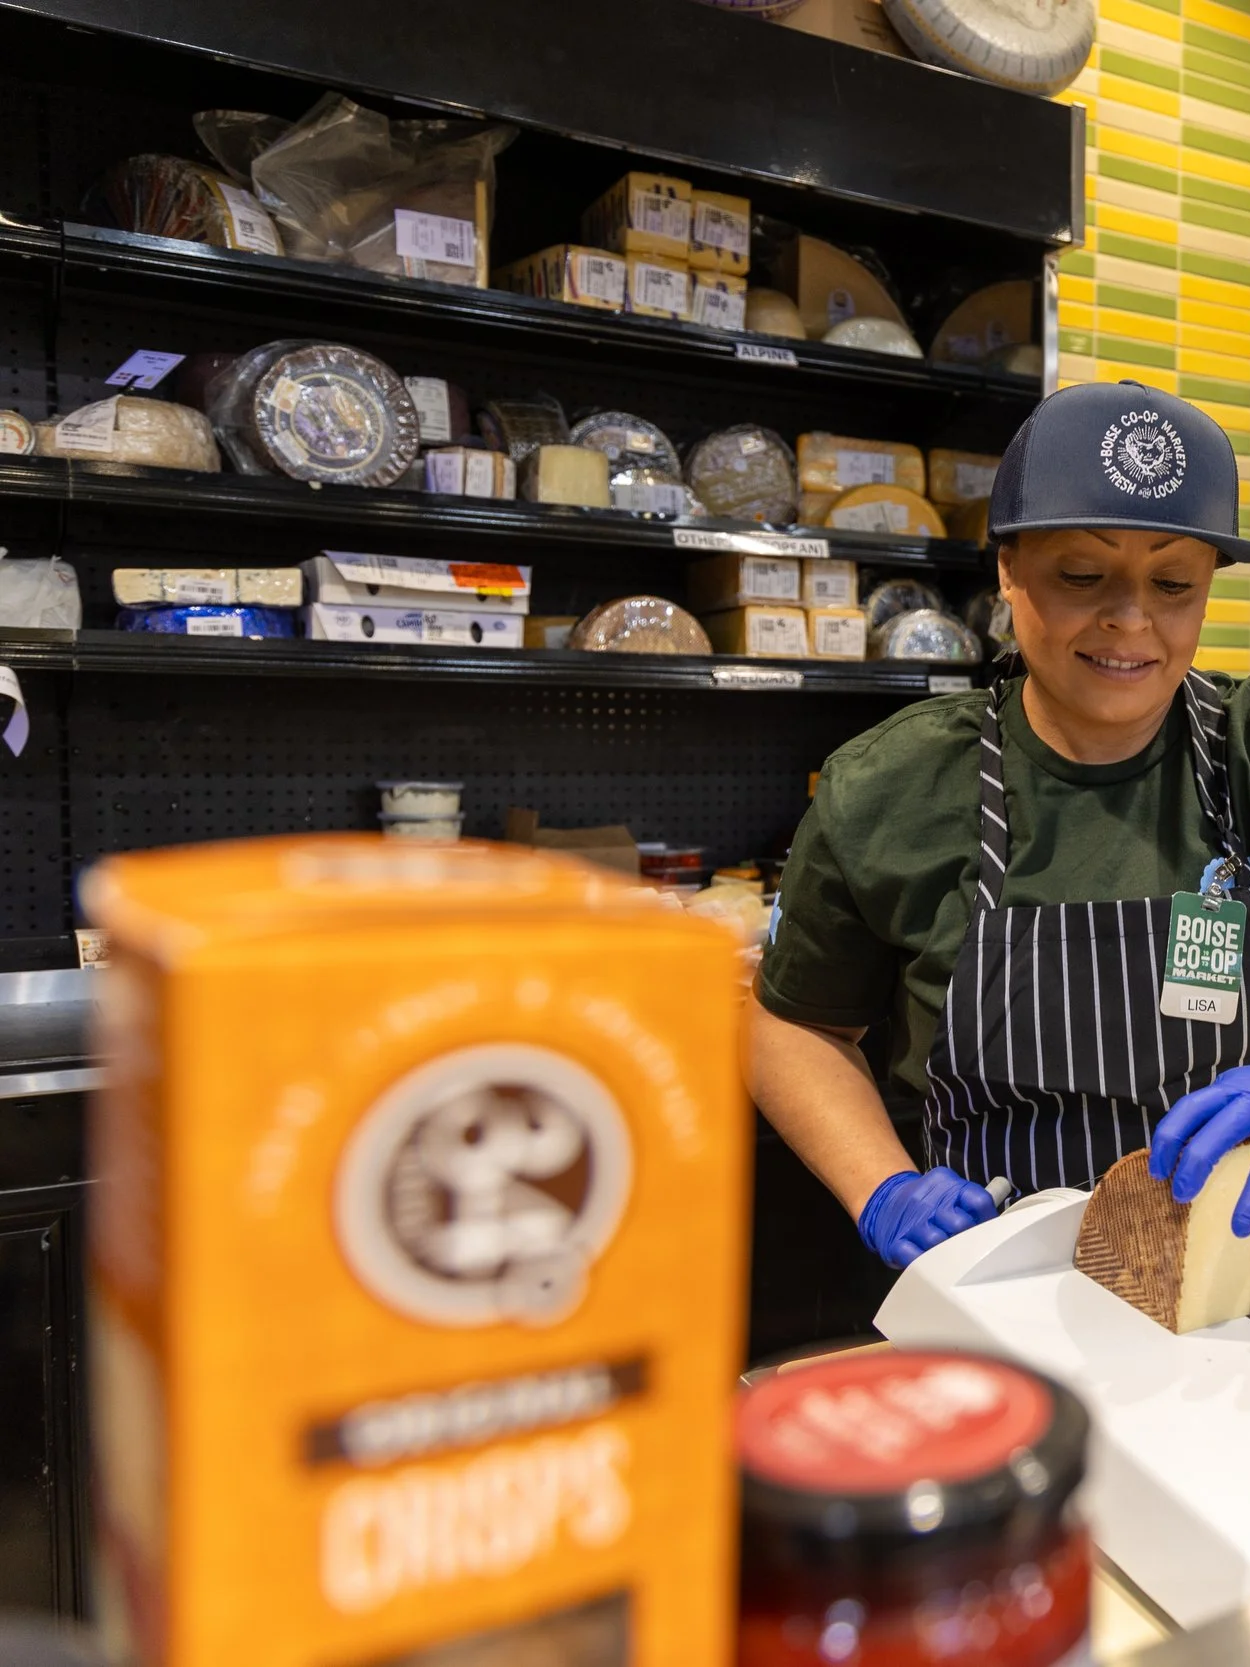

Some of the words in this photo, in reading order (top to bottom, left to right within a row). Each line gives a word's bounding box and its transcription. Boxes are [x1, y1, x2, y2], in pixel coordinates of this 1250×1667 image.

[741, 345, 790, 361] ALPINE
[1100, 423, 1122, 457] BOISE
[1120, 410, 1159, 427] CO-OP
[1161, 420, 1187, 468] MARKET
[1104, 465, 1137, 496] FRESH
[1153, 476, 1183, 499] LOCAL
[1175, 914, 1241, 950] BOISE
[1173, 942, 1238, 975] CO-OP
[1172, 968, 1236, 985] MARKET
[1187, 999, 1216, 1012] LISA
